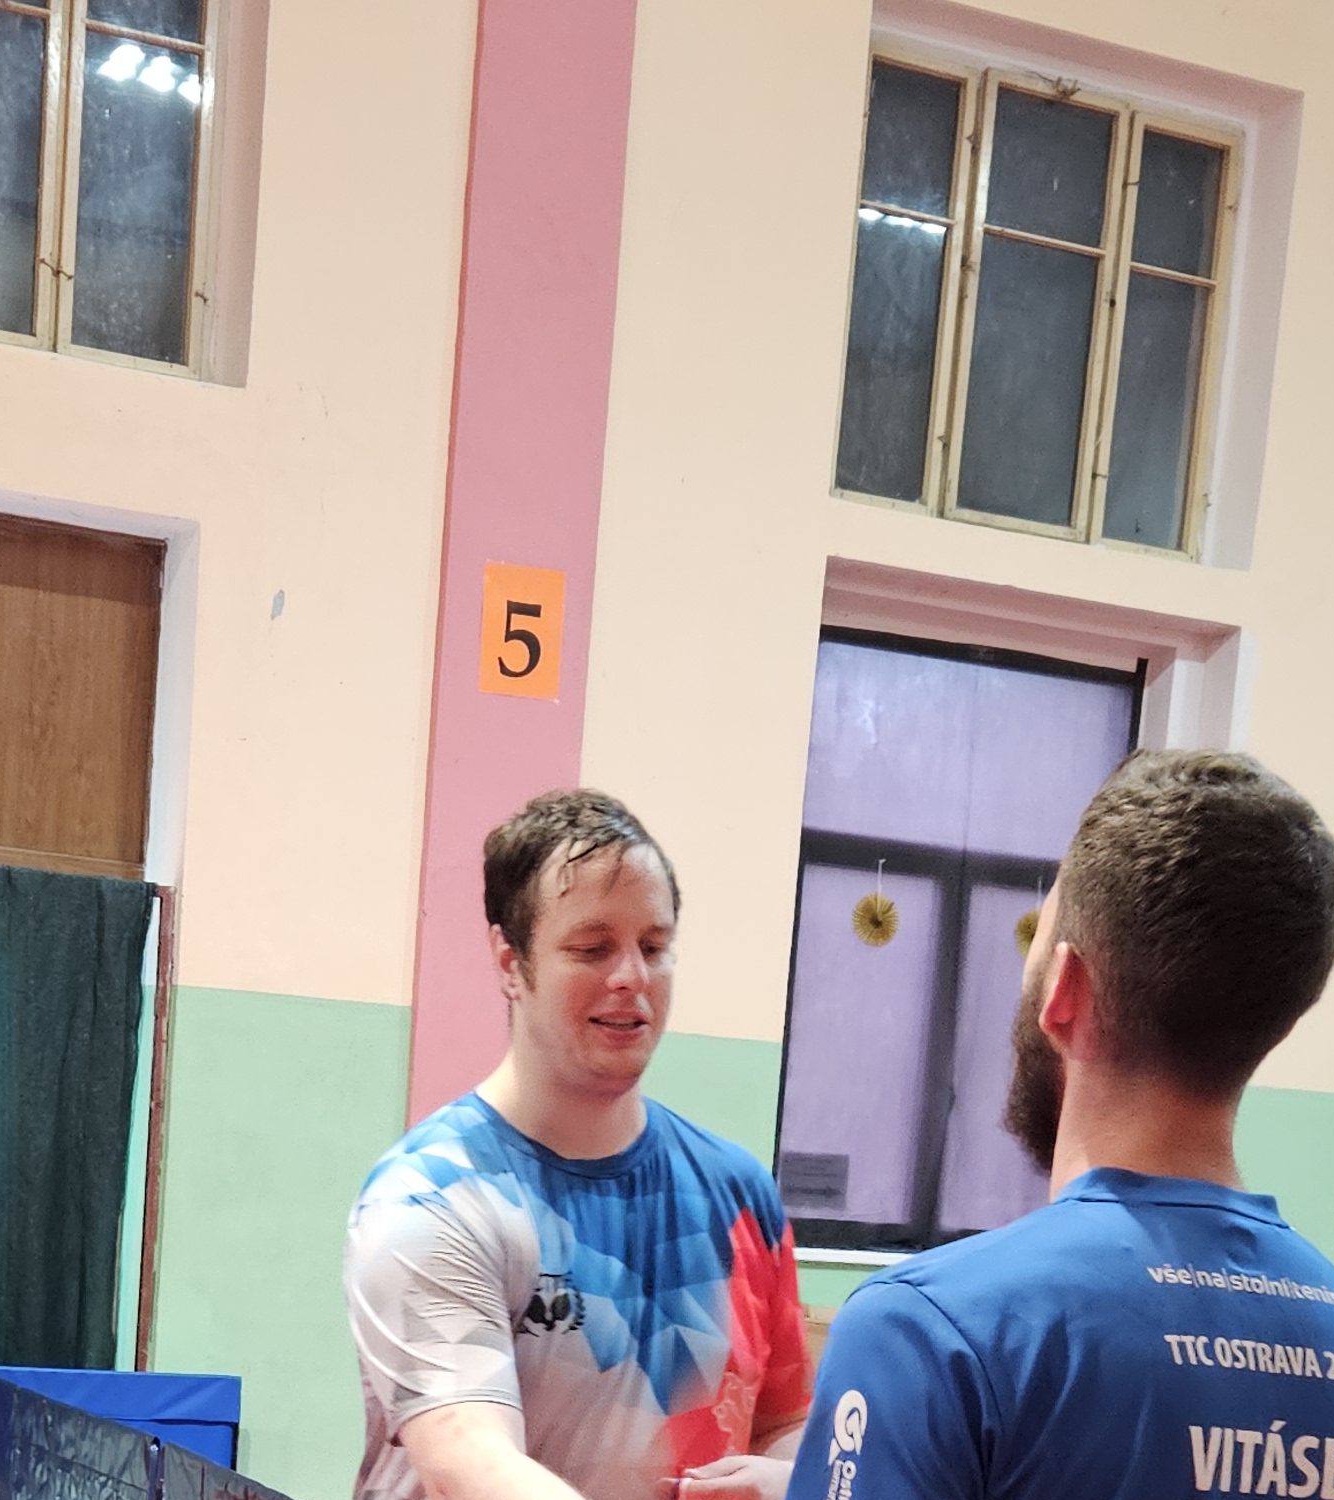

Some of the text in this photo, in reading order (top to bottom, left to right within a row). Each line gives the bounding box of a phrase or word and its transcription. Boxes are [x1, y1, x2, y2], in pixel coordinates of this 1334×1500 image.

[497, 599, 543, 679] 5
[1163, 1333, 1215, 1368] TTC
[1213, 1336, 1324, 1380] OSTRAVA
